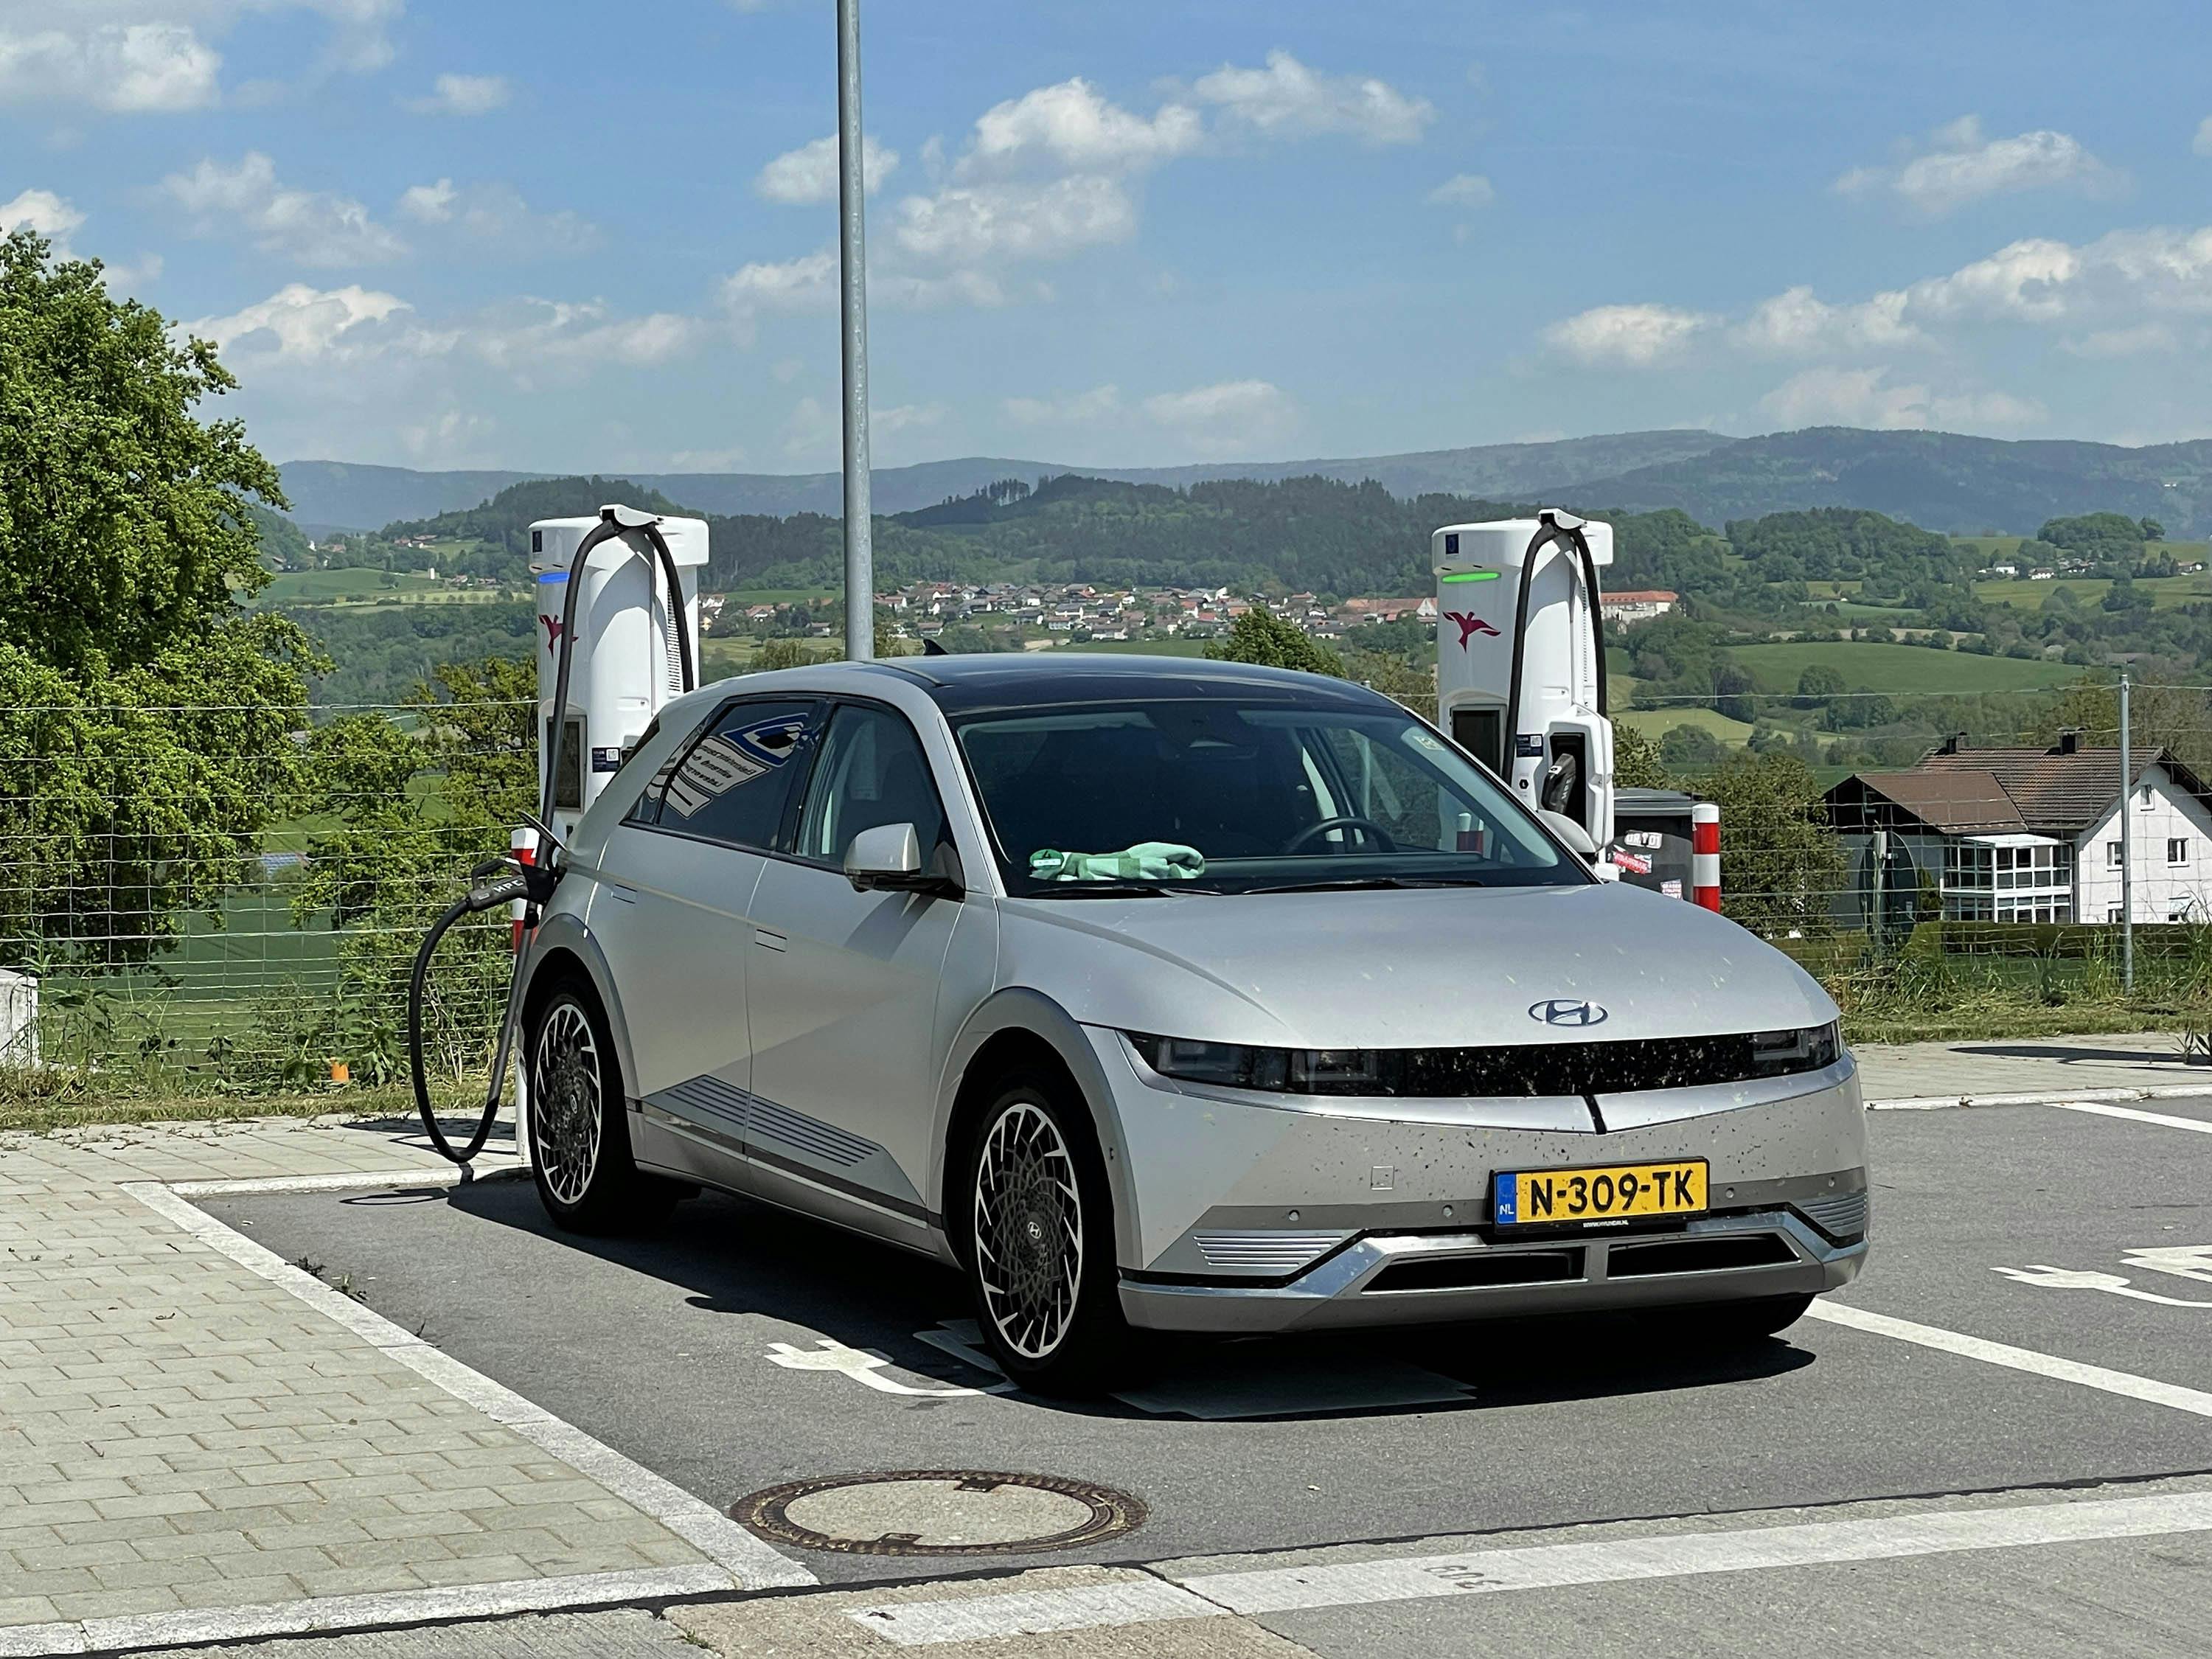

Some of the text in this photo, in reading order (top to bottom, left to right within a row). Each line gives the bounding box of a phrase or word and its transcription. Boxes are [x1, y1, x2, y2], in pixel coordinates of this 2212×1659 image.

[493, 880, 524, 893] HPC
[1499, 1169, 1694, 1217] NL N-309-TK
